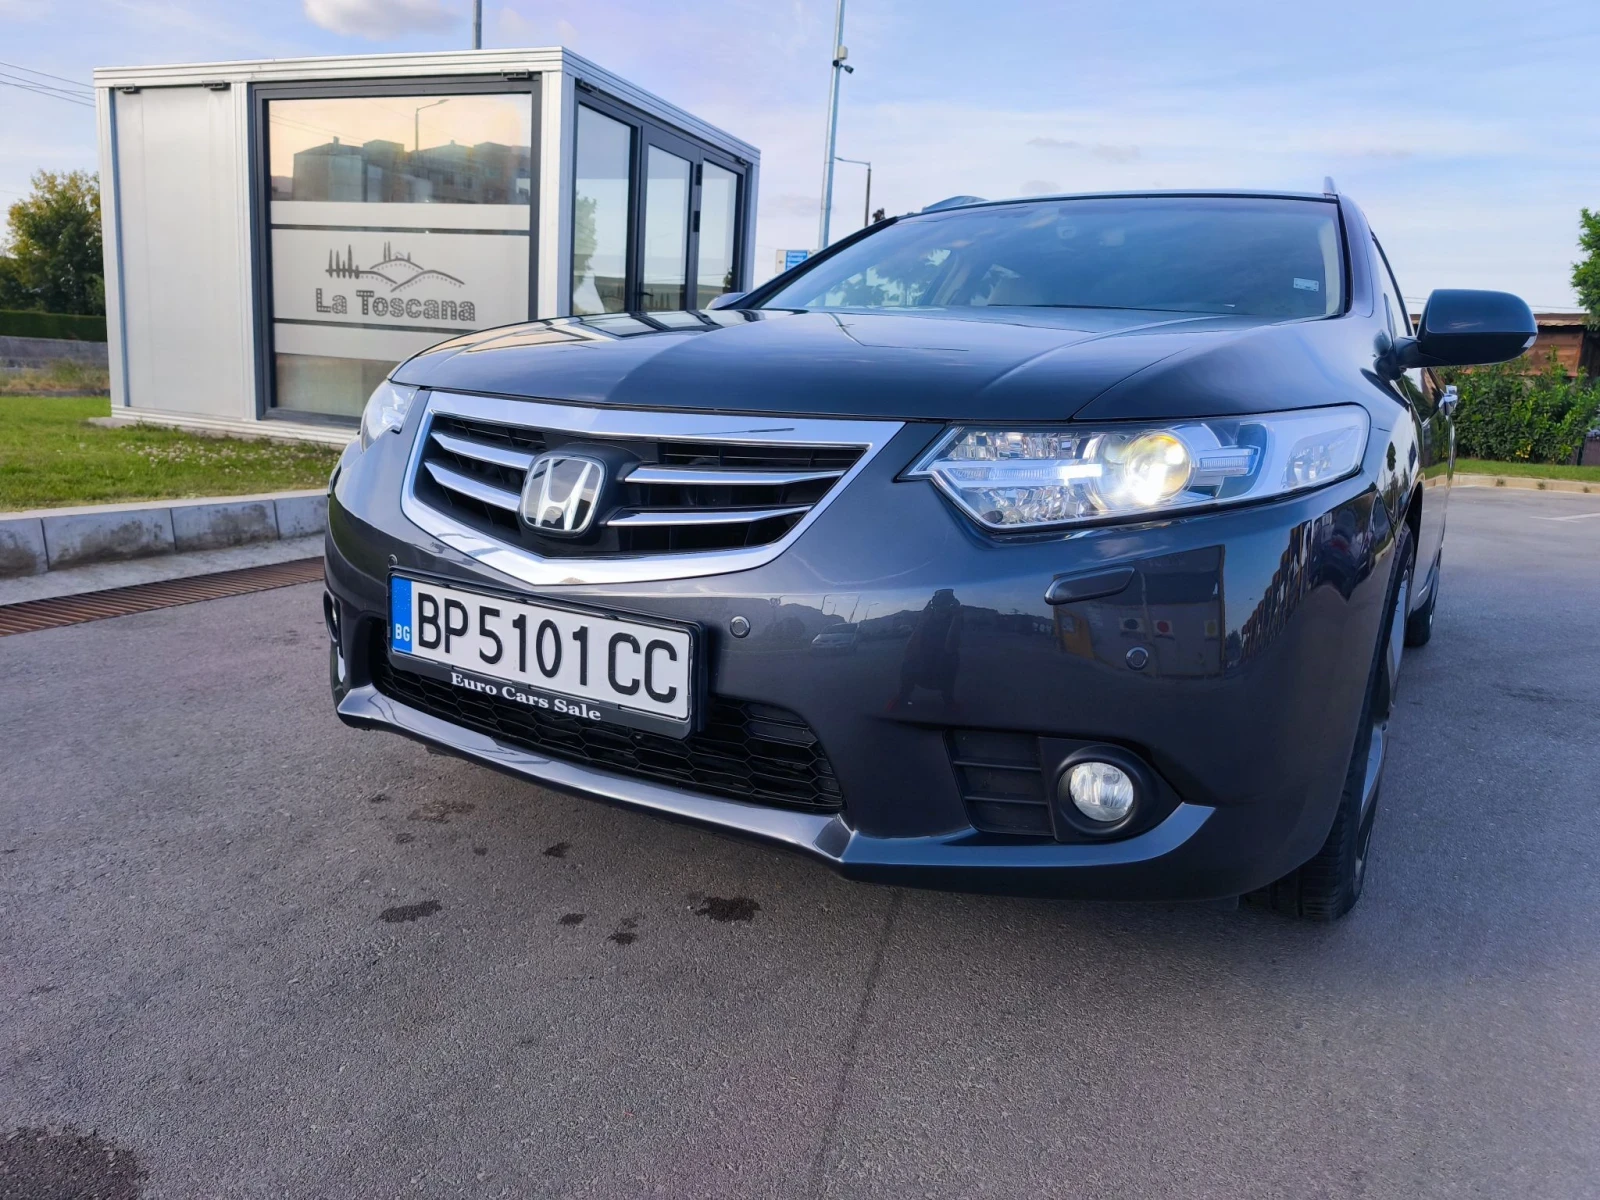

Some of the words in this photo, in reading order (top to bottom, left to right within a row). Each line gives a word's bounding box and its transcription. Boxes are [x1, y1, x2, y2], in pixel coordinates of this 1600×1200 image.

[316, 288, 347, 314] La
[356, 290, 476, 321] Toscana
[395, 623, 410, 641] BG
[451, 672, 498, 695] Euro
[502, 686, 549, 708] Cars
[554, 699, 602, 720] Sale
